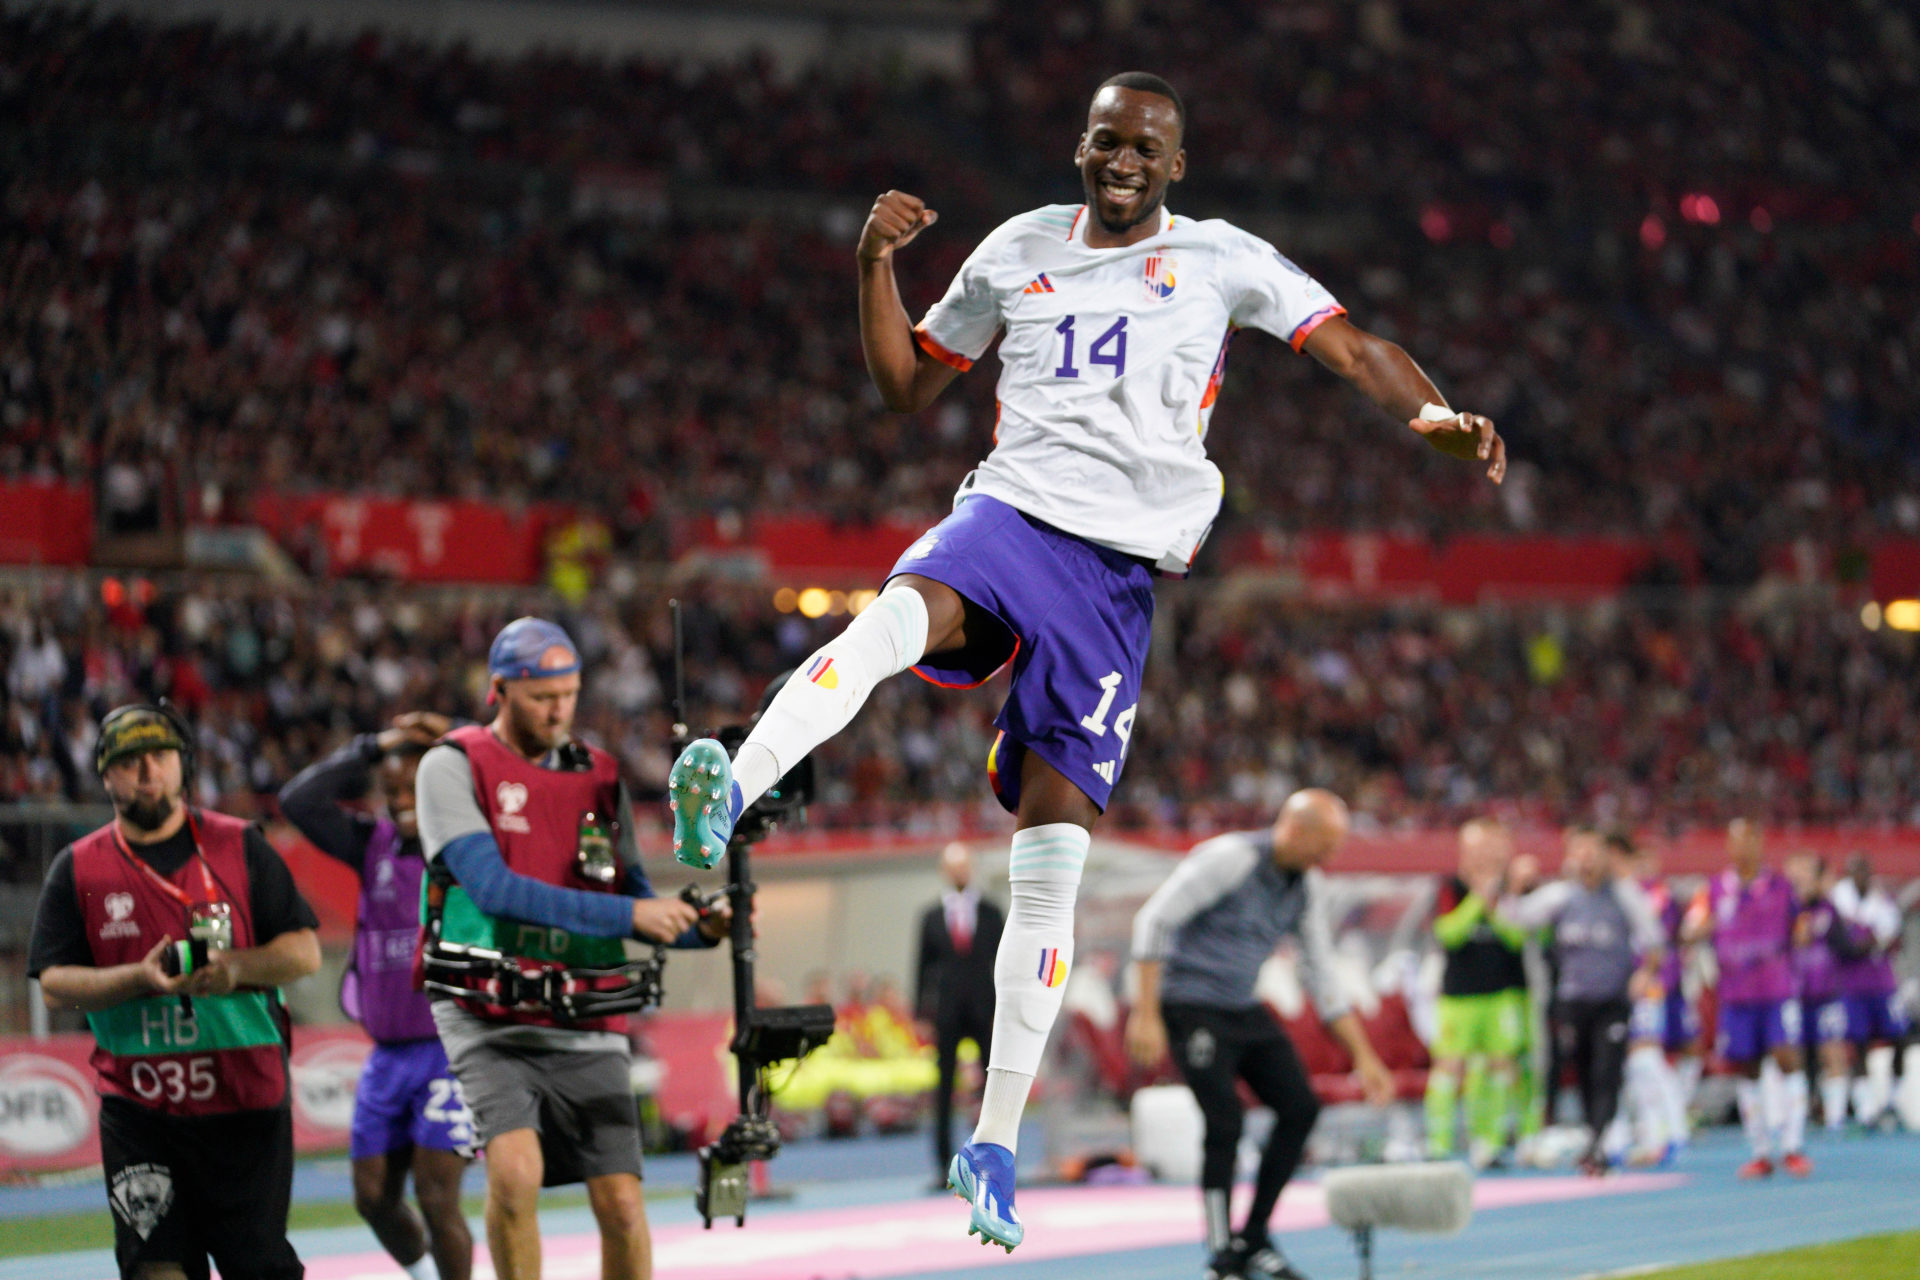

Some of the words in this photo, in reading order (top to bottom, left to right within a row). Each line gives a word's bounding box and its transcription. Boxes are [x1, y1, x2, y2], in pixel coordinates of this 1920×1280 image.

[1055, 314, 1128, 379] 14
[1080, 670, 1137, 760] 14
[141, 1004, 199, 1047] HB
[131, 1056, 217, 1104] 035
